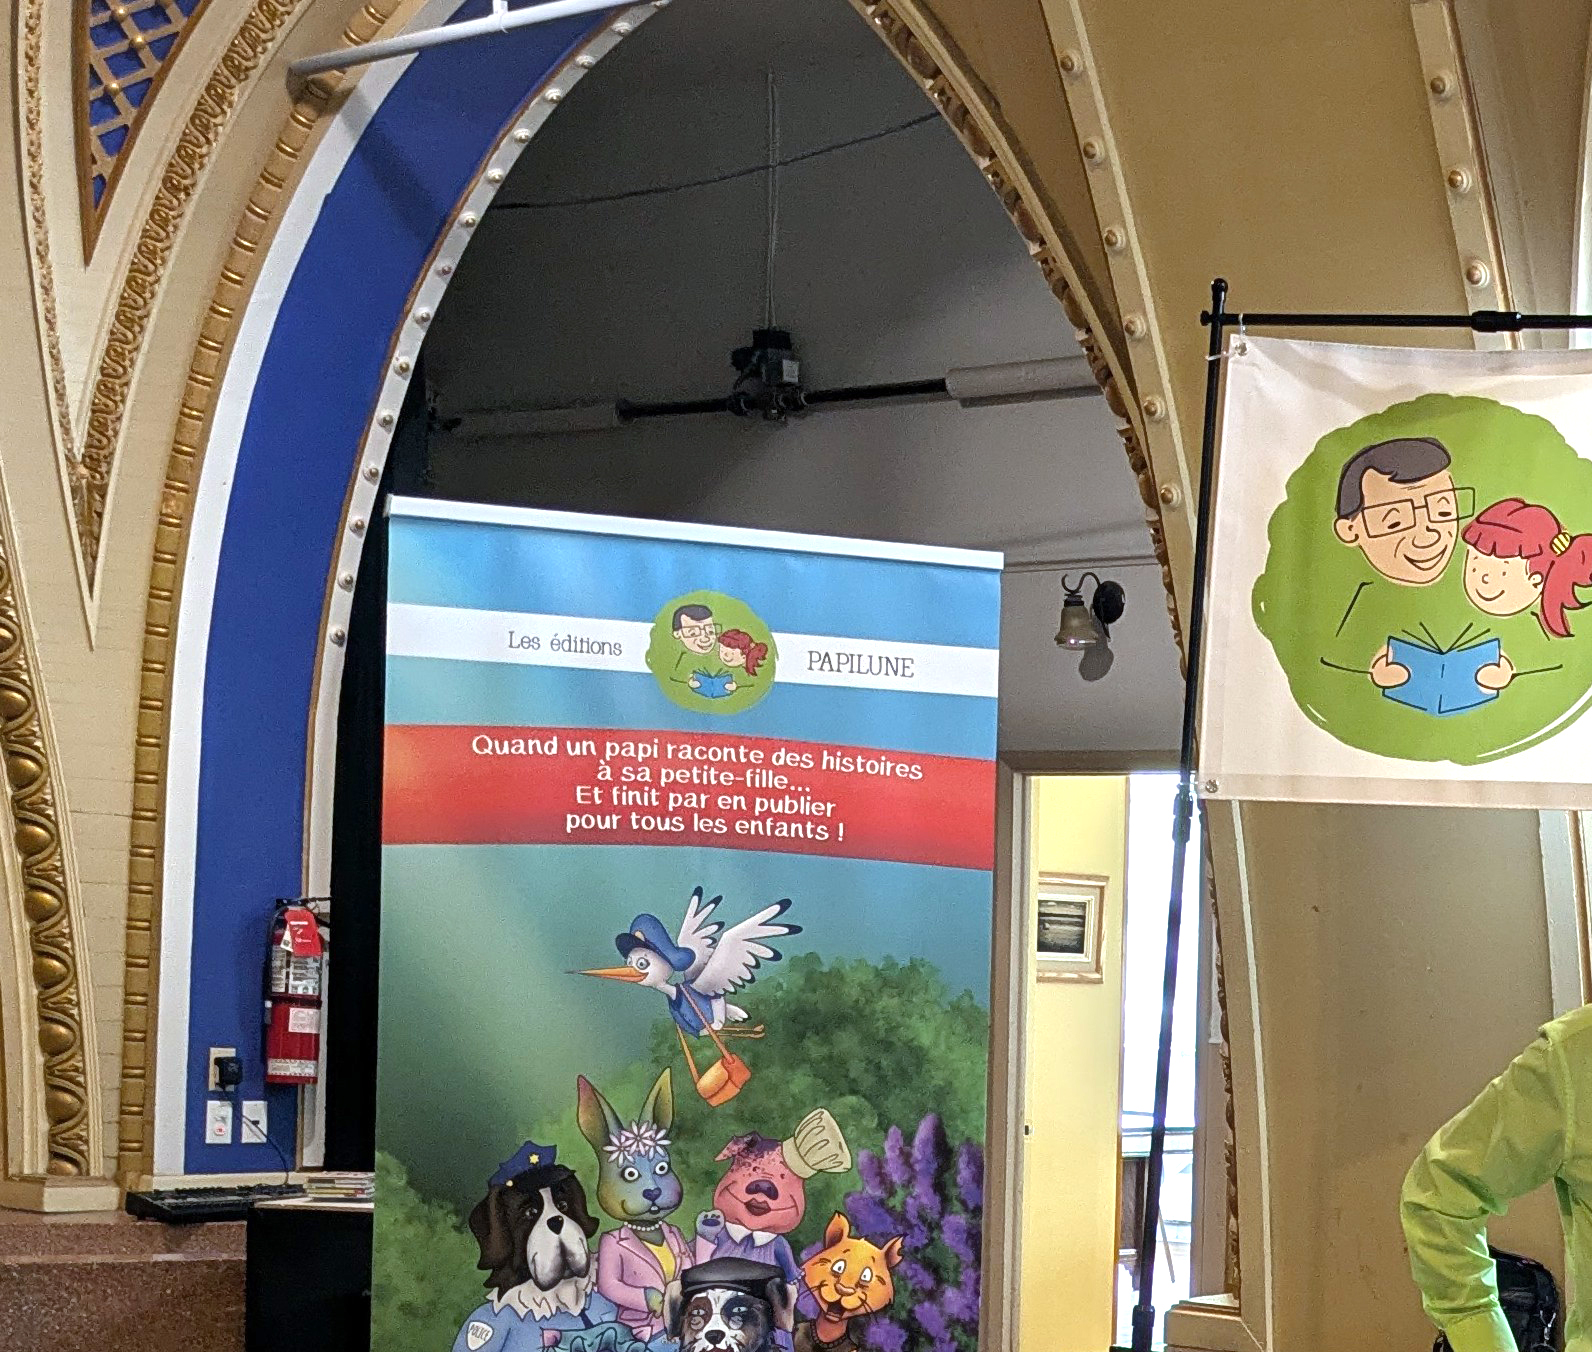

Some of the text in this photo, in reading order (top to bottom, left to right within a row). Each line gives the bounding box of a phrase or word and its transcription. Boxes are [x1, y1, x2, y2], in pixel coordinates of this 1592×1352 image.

[508, 630, 915, 679] Les éditions PAPILUNE
[472, 734, 923, 780] Quand un papi raconte des histoires
[597, 759, 811, 792] à sa petite-fille...
[576, 785, 836, 817] Et finit par en publier
[566, 812, 844, 842] pour tous les enfants !
[470, 1324, 490, 1341] POLICE
